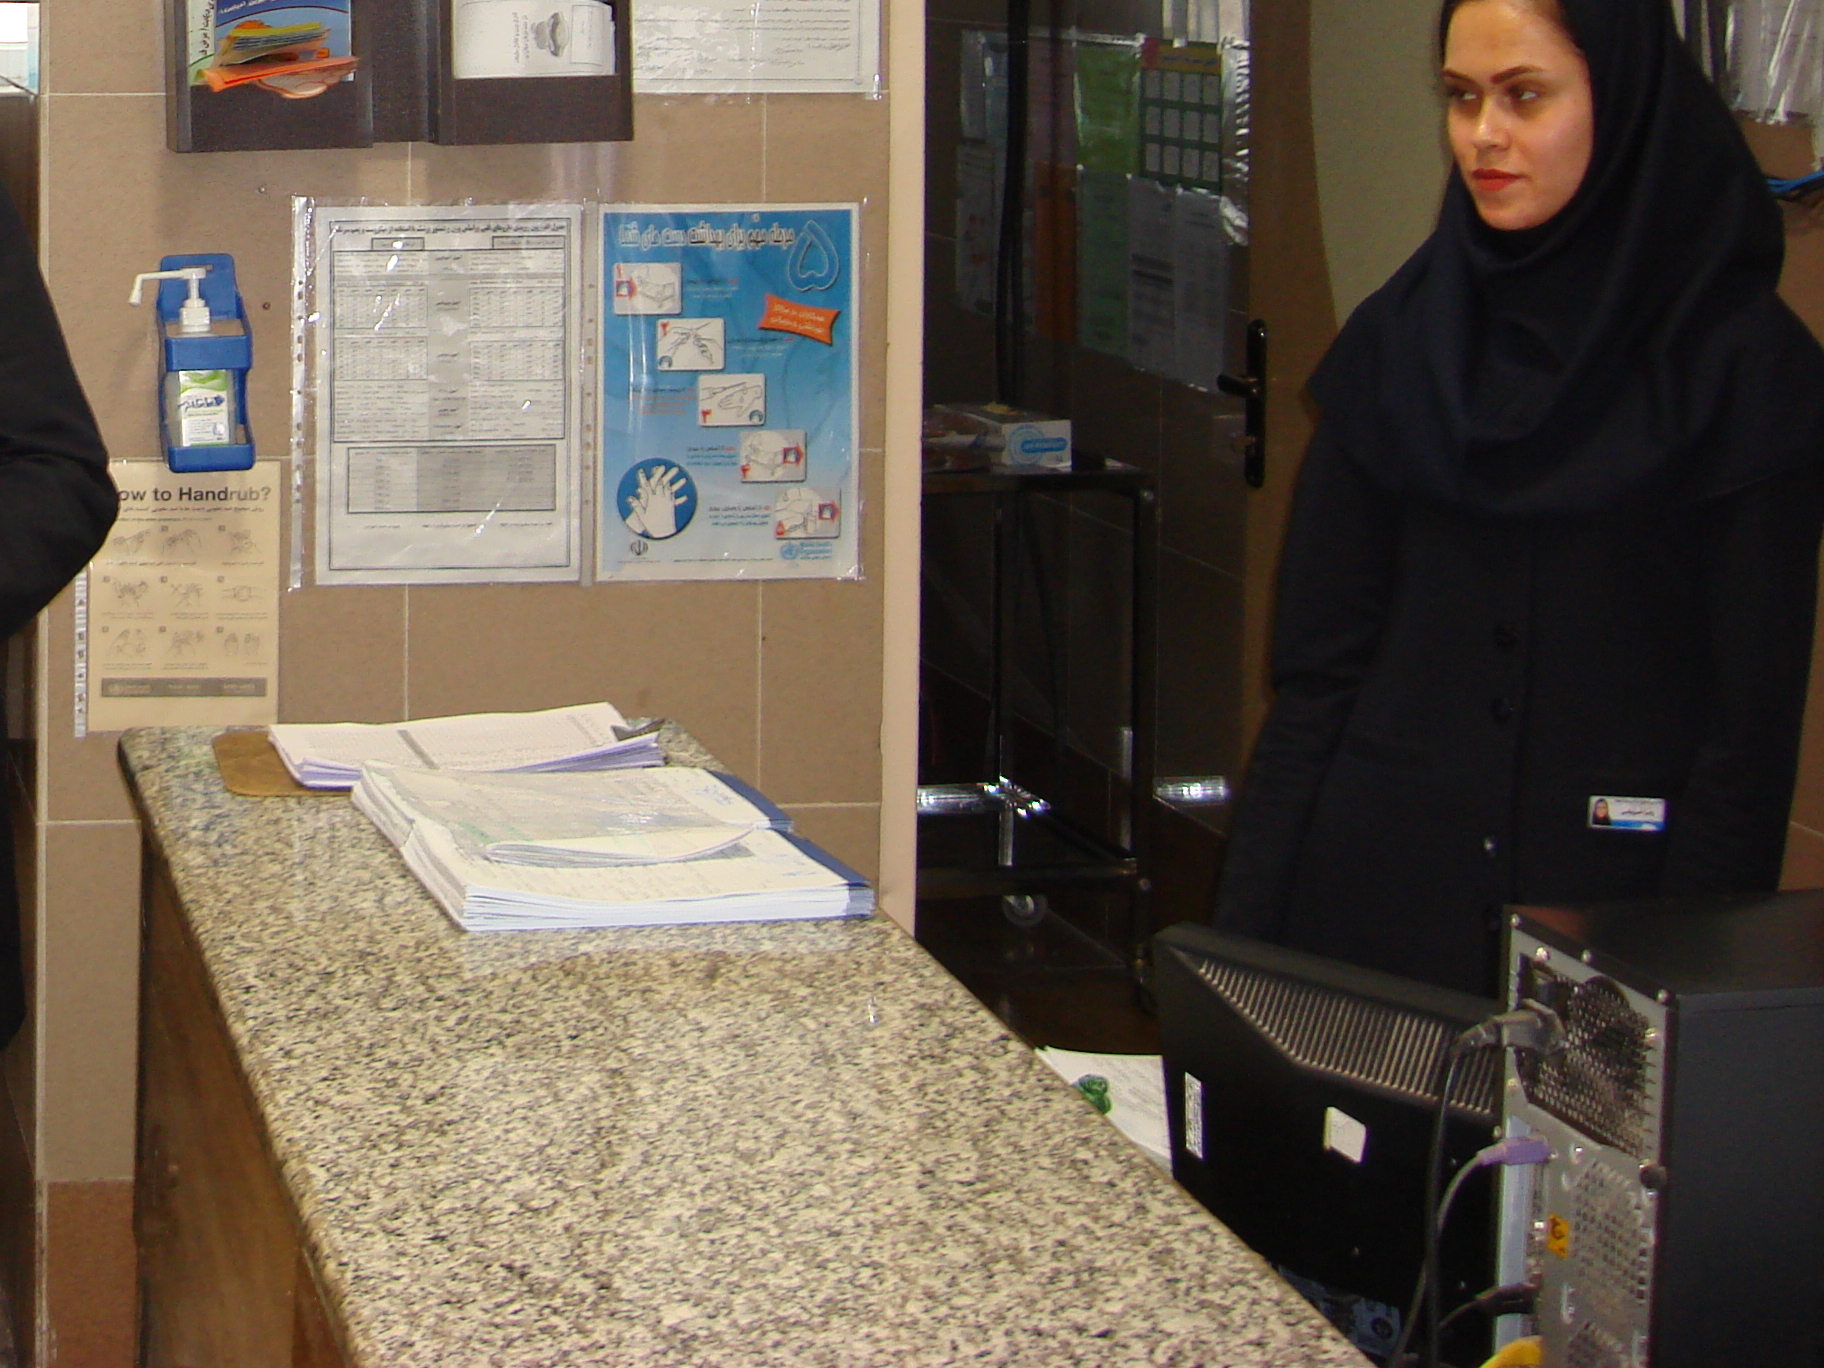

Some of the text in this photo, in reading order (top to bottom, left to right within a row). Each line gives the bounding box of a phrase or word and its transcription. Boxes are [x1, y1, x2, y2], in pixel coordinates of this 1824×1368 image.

[619, 220, 640, 248] شما
[641, 224, 660, 251] های
[661, 226, 686, 247] دست
[688, 220, 724, 250] بهداشت
[725, 223, 746, 250] برای
[768, 222, 796, 249] مرحله
[787, 219, 840, 292] ۵
[118, 486, 272, 502] ow to Handrub?
